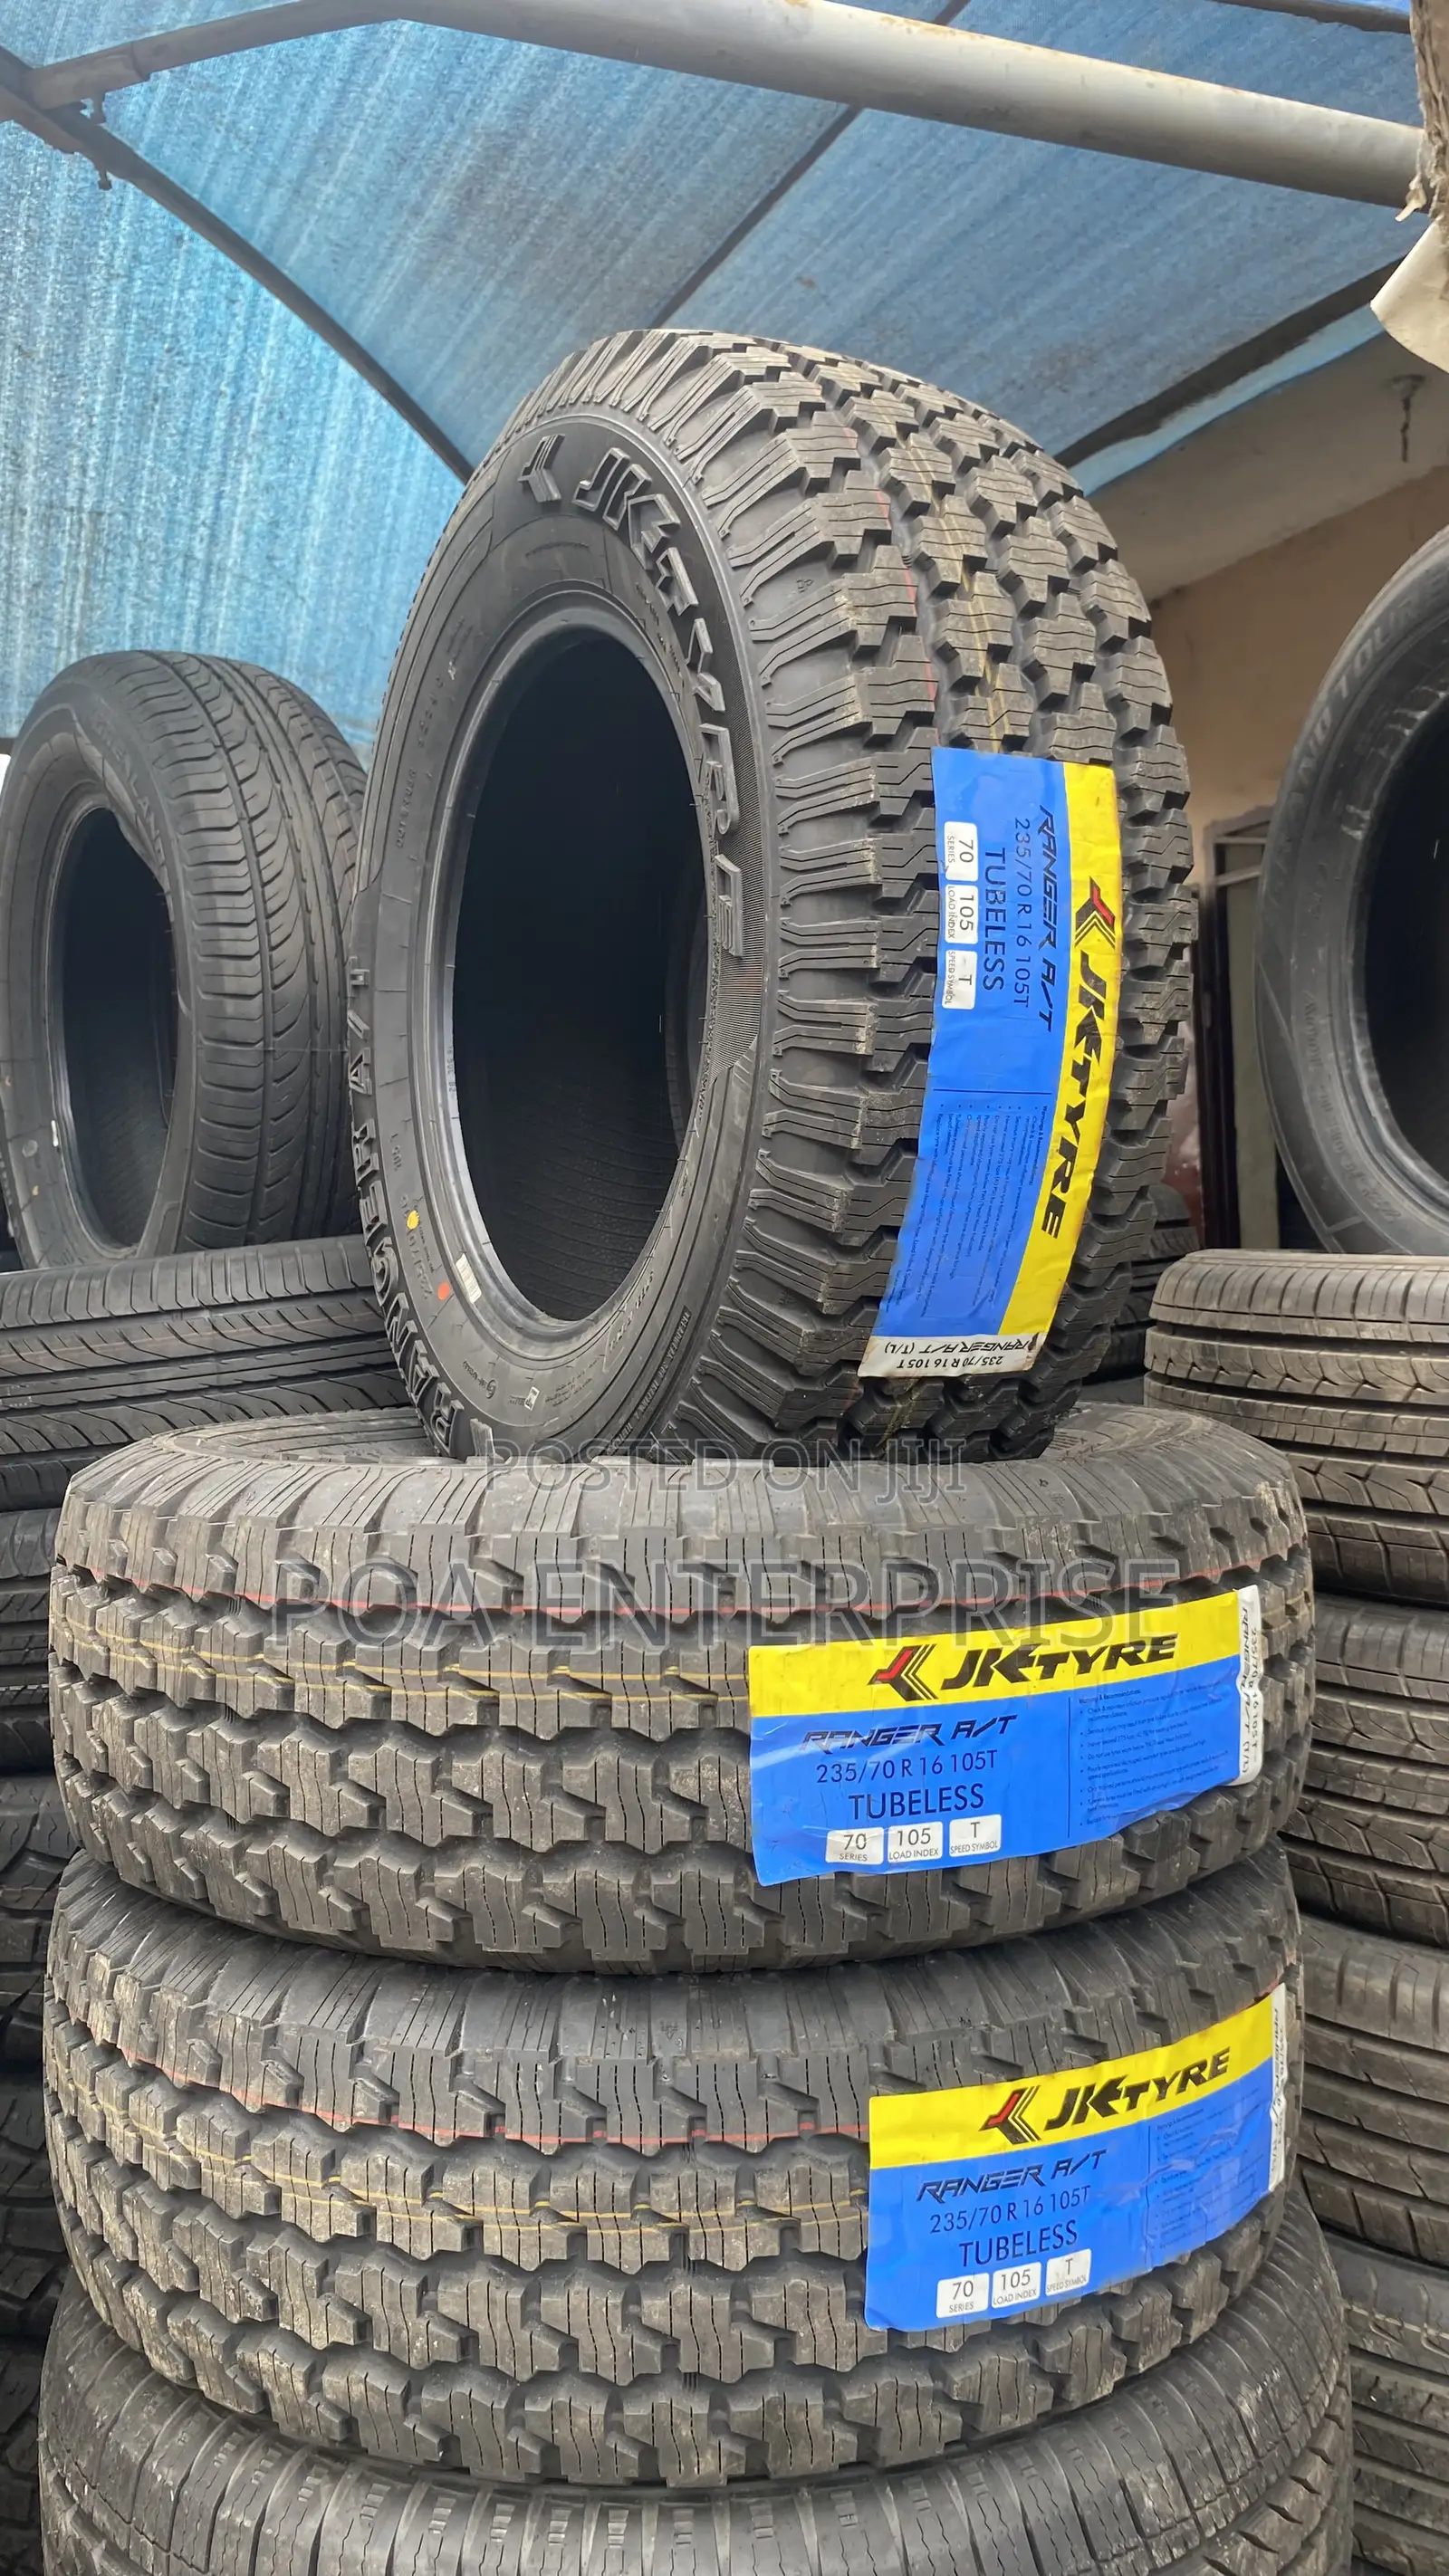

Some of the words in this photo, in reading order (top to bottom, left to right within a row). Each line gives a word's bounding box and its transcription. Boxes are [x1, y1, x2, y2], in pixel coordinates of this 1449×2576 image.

[946, 835, 955, 863] SERIES
[959, 838, 974, 864] 70
[1014, 818, 1032, 897] 235/70
[1038, 805, 1058, 951] RANGER
[947, 886, 955, 911] LOAD
[1017, 904, 1032, 915] R
[959, 894, 974, 931] 105
[983, 847, 1006, 991] TUBELESS
[1016, 923, 1032, 948] 16
[945, 974, 955, 1005] SYMBOL
[959, 973, 973, 986] T
[1014, 955, 1032, 1008] 105T
[1038, 958, 1057, 1032] A/T
[1041, 949, 1108, 1240] JKTYRE
[352, 1118, 464, 1460] RANGER
[885, 1342, 915, 1355] (T/L)
[919, 1344, 959, 1354] A/T
[959, 1339, 1030, 1353] RANGER
[934, 1358, 948, 1368] 16
[951, 1358, 960, 1367] R
[962, 1355, 1004, 1367] 235/70
[940, 1633, 1179, 1690] JKTYRE
[799, 1723, 945, 1755] RANGER
[951, 1714, 1018, 1739] A/T
[817, 1760, 895, 1784] 235/70
[902, 1758, 913, 1777] R
[920, 1754, 943, 1776] 16
[951, 1749, 998, 1772] 105T
[849, 1783, 984, 1820] TUBELESS
[843, 1834, 867, 1851] 70
[897, 1827, 931, 1846] 105
[970, 1822, 980, 1839] T
[839, 1853, 868, 1863] SERIES
[889, 1850, 912, 1861] LOAD
[913, 1847, 939, 1858] INDEX
[950, 1844, 971, 1854] SPEED
[972, 1840, 998, 1852] SYMBOL
[1044, 2046, 1231, 2131] JKTYRE
[916, 2164, 1047, 2204] RANGER
[1051, 2149, 1107, 2179] A/T
[930, 2205, 1002, 2234] 235/70
[1007, 2202, 1018, 2221] R
[1023, 2196, 1043, 2218] 16
[1051, 2185, 1091, 2212] 105T
[959, 2219, 1078, 2267] TUBELESS
[1065, 2258, 1074, 2275] T
[952, 2280, 974, 2300] 70
[1001, 2269, 1031, 2291] 105
[1046, 2281, 1064, 2293] SPEED
[949, 2303, 974, 2313] SERIES
[993, 2294, 1014, 2305] LOAD
[1014, 2289, 1037, 2302] INDEX
